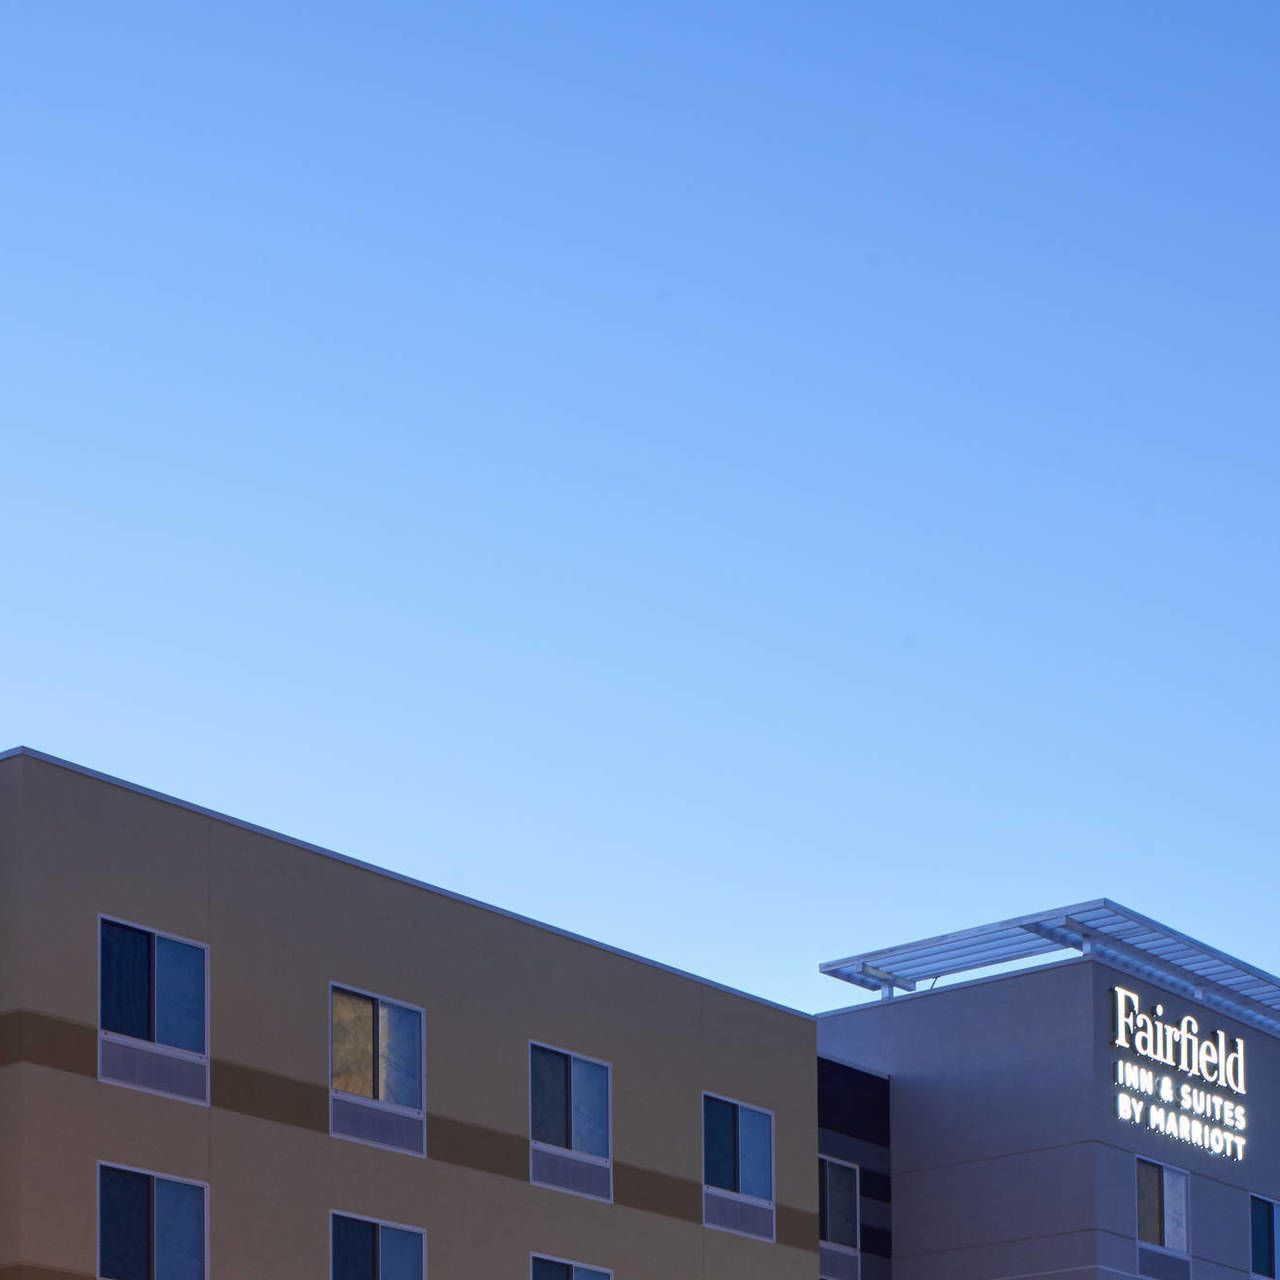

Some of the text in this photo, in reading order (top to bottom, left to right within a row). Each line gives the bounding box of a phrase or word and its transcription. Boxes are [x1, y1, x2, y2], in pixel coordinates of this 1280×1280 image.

[1115, 986, 1247, 1094] Fairfield
[1117, 1060, 1246, 1130] INN & SUITES
[1118, 1093, 1246, 1161] BY MARRIOTT
